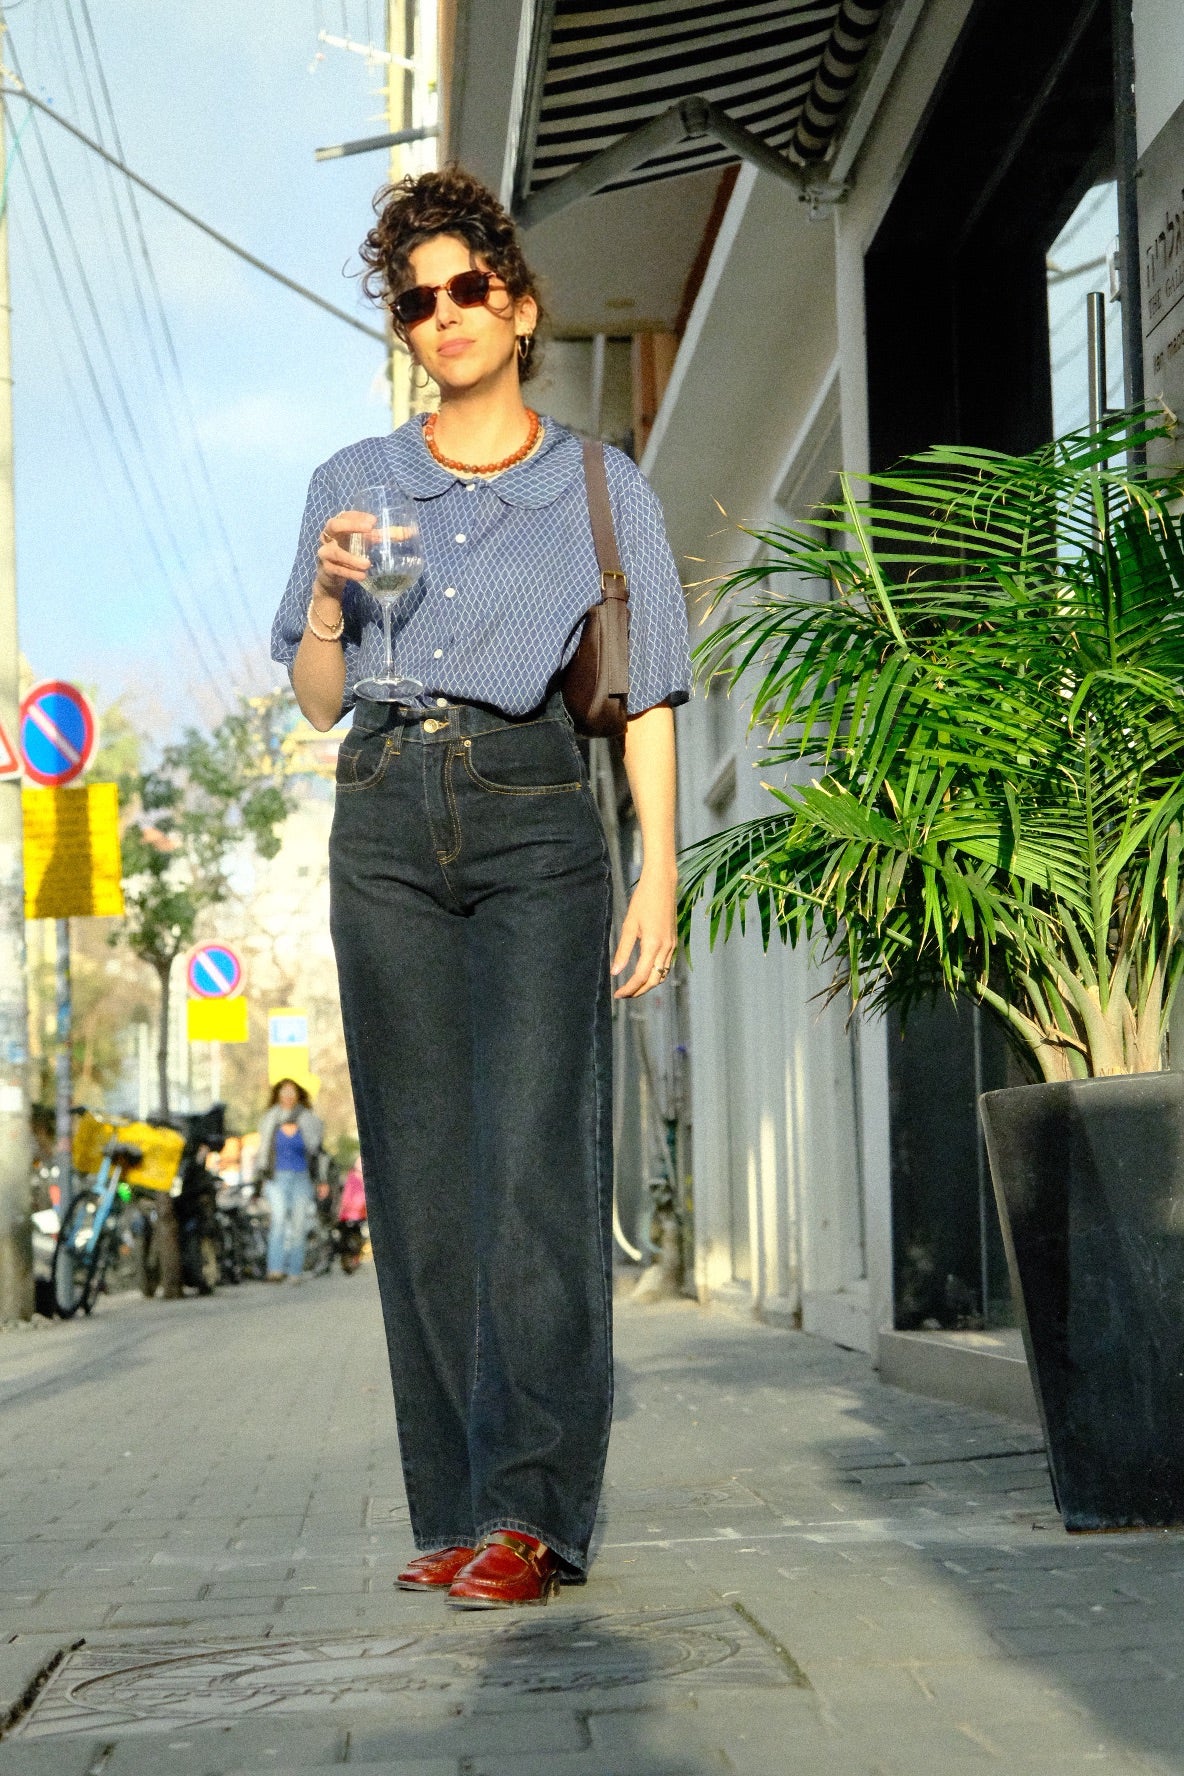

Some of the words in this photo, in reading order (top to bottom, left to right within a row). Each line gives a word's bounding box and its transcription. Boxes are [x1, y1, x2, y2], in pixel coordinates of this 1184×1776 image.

[1146, 187, 1184, 288] גלריה
[1148, 288, 1161, 319] THE
[1166, 260, 1184, 297] GALL
